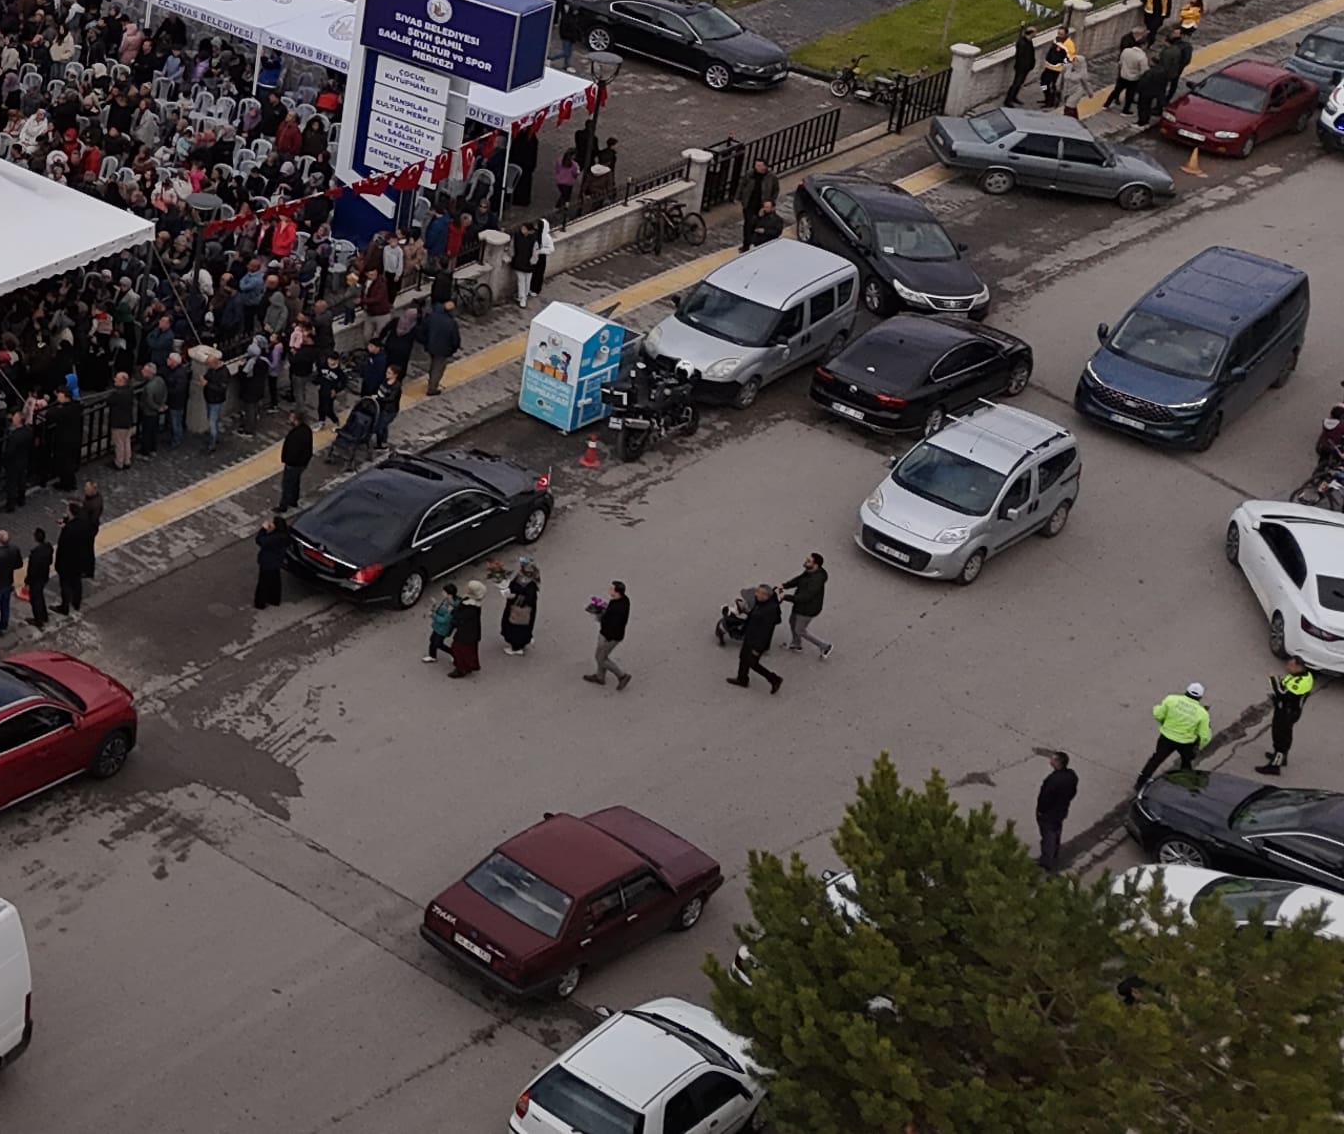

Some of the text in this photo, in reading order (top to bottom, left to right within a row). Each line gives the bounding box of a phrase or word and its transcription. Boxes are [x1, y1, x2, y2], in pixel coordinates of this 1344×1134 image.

[200, 12, 254, 39] BELEDİYESİ
[465, 57, 492, 72] SPOR
[398, 69, 426, 83] ÇOCUK
